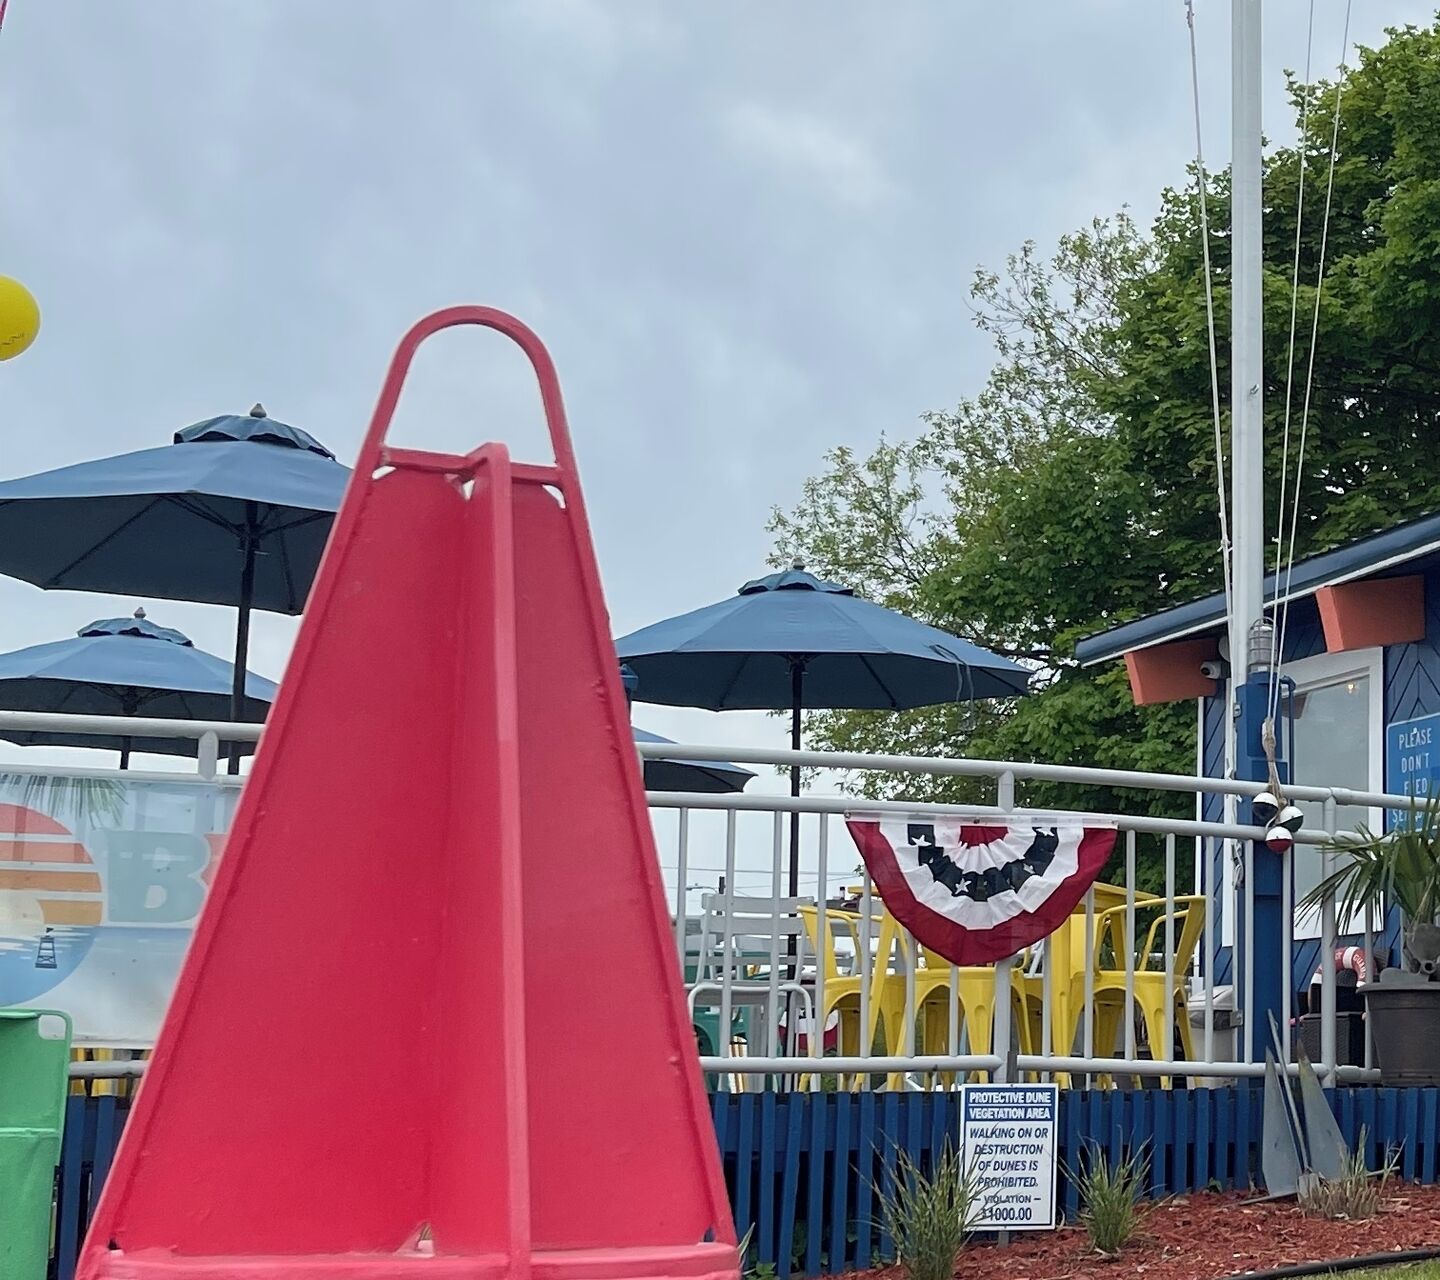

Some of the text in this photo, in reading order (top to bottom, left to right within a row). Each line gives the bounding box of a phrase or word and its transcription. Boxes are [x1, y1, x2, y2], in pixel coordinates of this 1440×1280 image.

[1399, 728, 1432, 750] PLEASE
[1404, 778, 1428, 797] FED
[969, 1092, 1051, 1104] PROTECTIVE DUNE
[969, 1107, 1051, 1119] VEGETATION AREA
[969, 1128, 1049, 1138] WALKING ON OR
[974, 1144, 1043, 1155] DESTRUCTION
[978, 1160, 1038, 1171] OF DUNES IS
[984, 1194, 1032, 1204] VIOLATION
